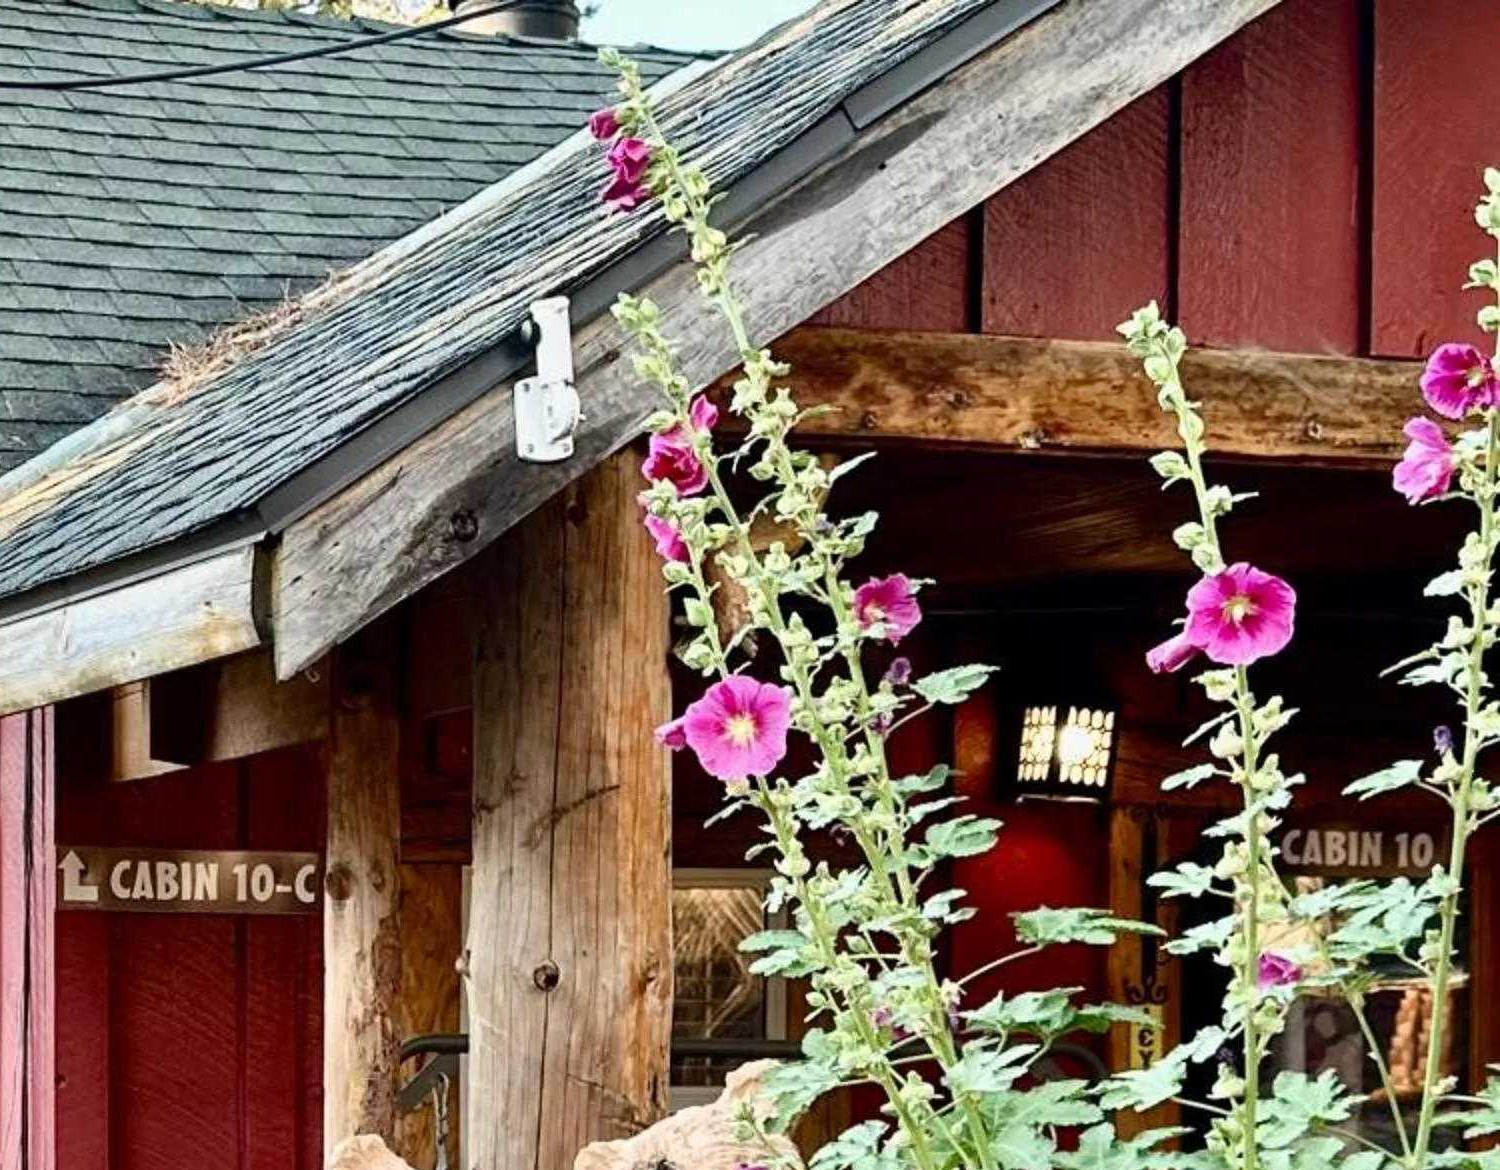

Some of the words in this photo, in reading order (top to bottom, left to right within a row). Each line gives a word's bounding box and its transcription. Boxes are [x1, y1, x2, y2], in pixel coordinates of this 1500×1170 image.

[1281, 829, 1383, 867] CABIN
[1395, 832, 1435, 868] 10
[109, 860, 219, 901] CABIN
[232, 863, 316, 903] 10-C
